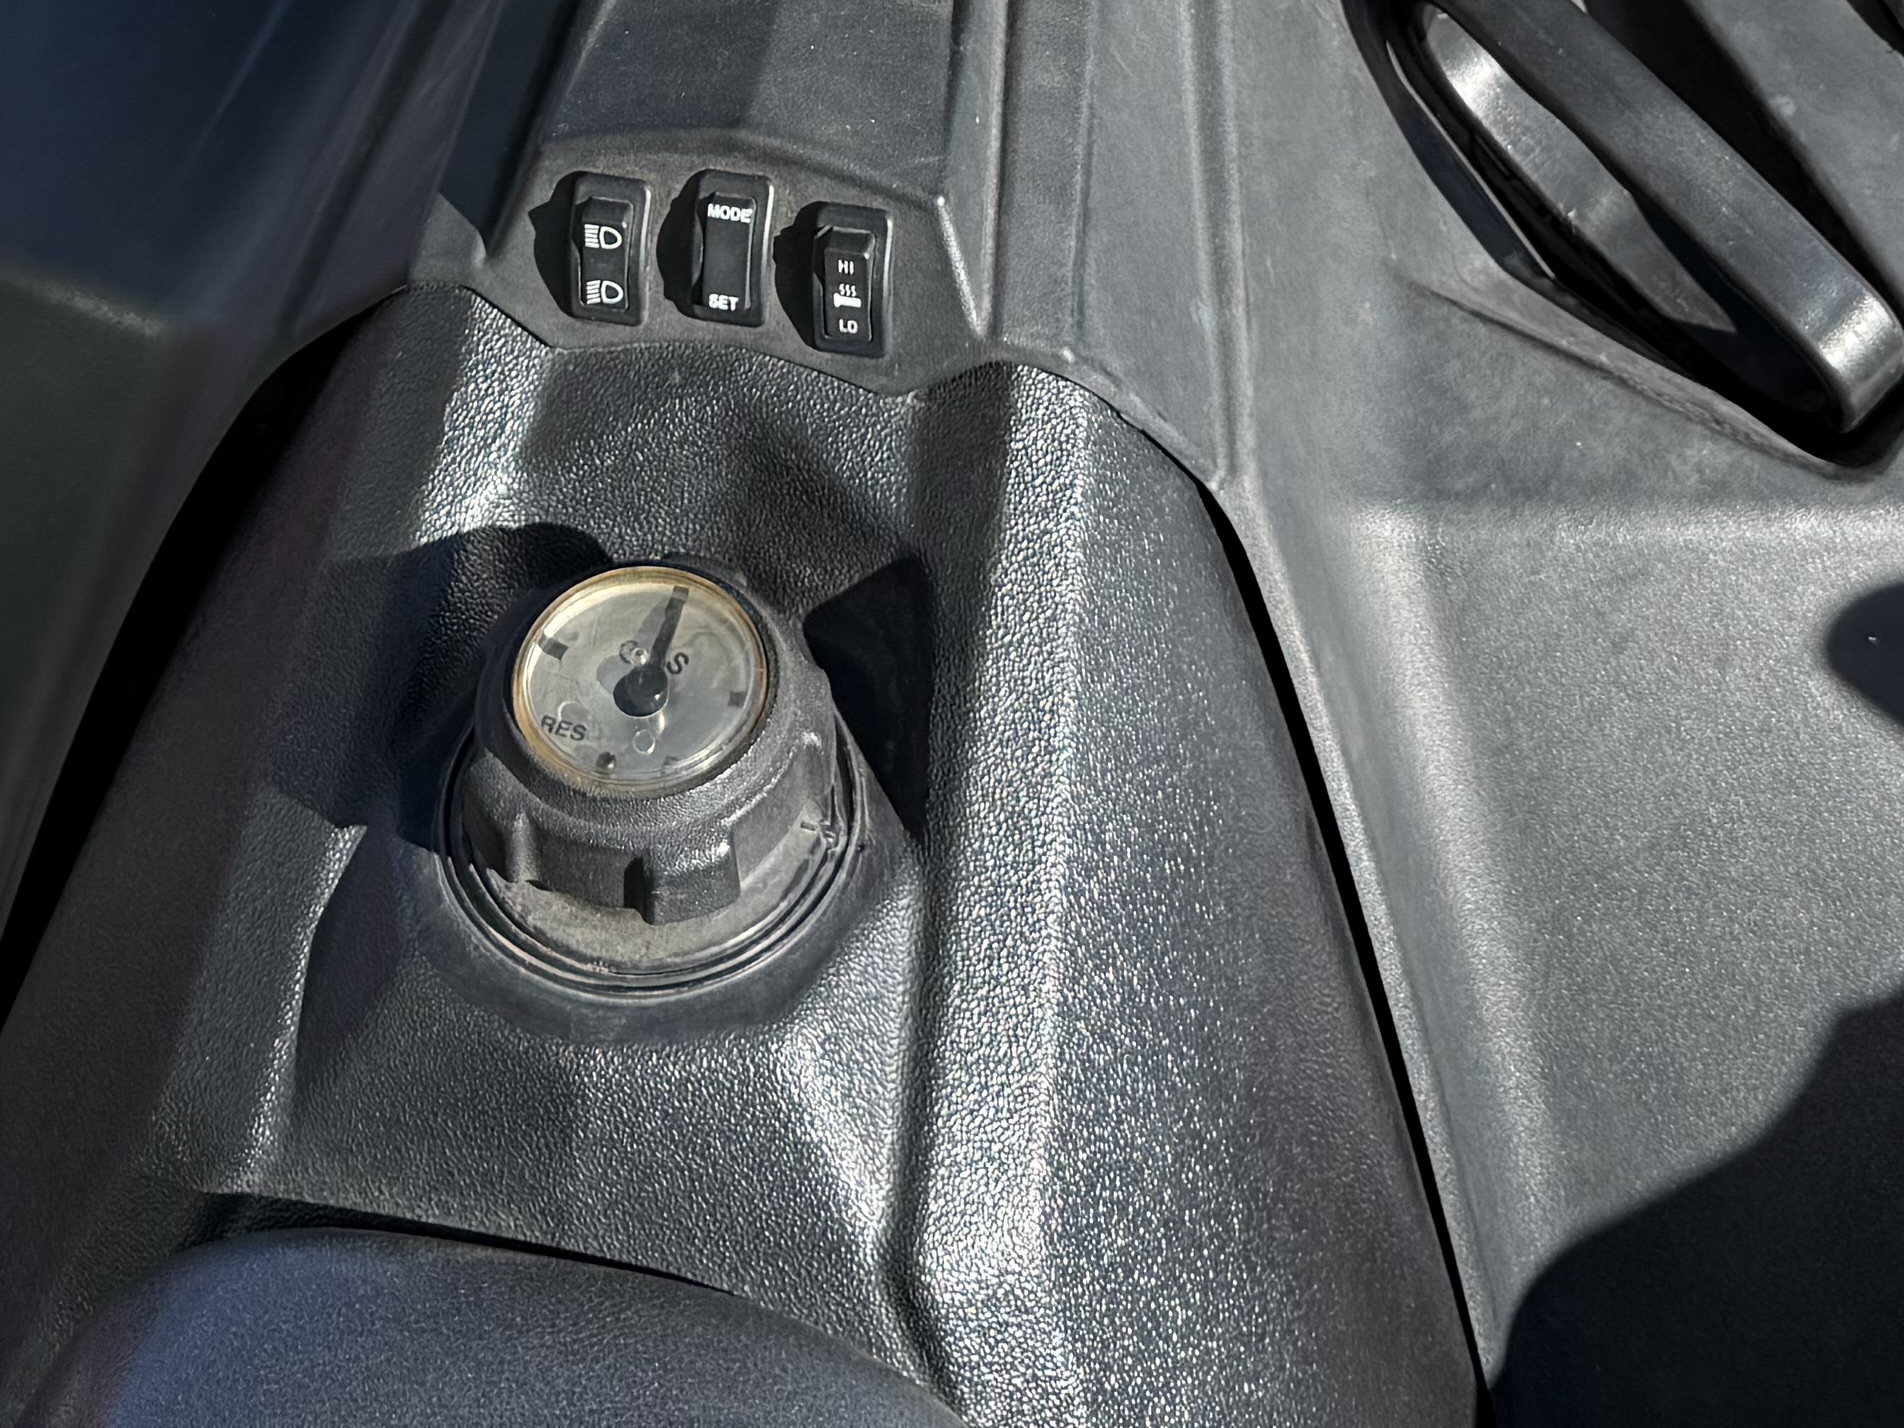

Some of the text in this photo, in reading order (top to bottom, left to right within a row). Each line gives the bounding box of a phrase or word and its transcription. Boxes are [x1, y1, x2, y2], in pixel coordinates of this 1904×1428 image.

[707, 203, 753, 224] MODE
[837, 259, 855, 275] HI
[708, 293, 739, 311] SET
[838, 318, 858, 334] LO
[540, 714, 588, 742] RES
